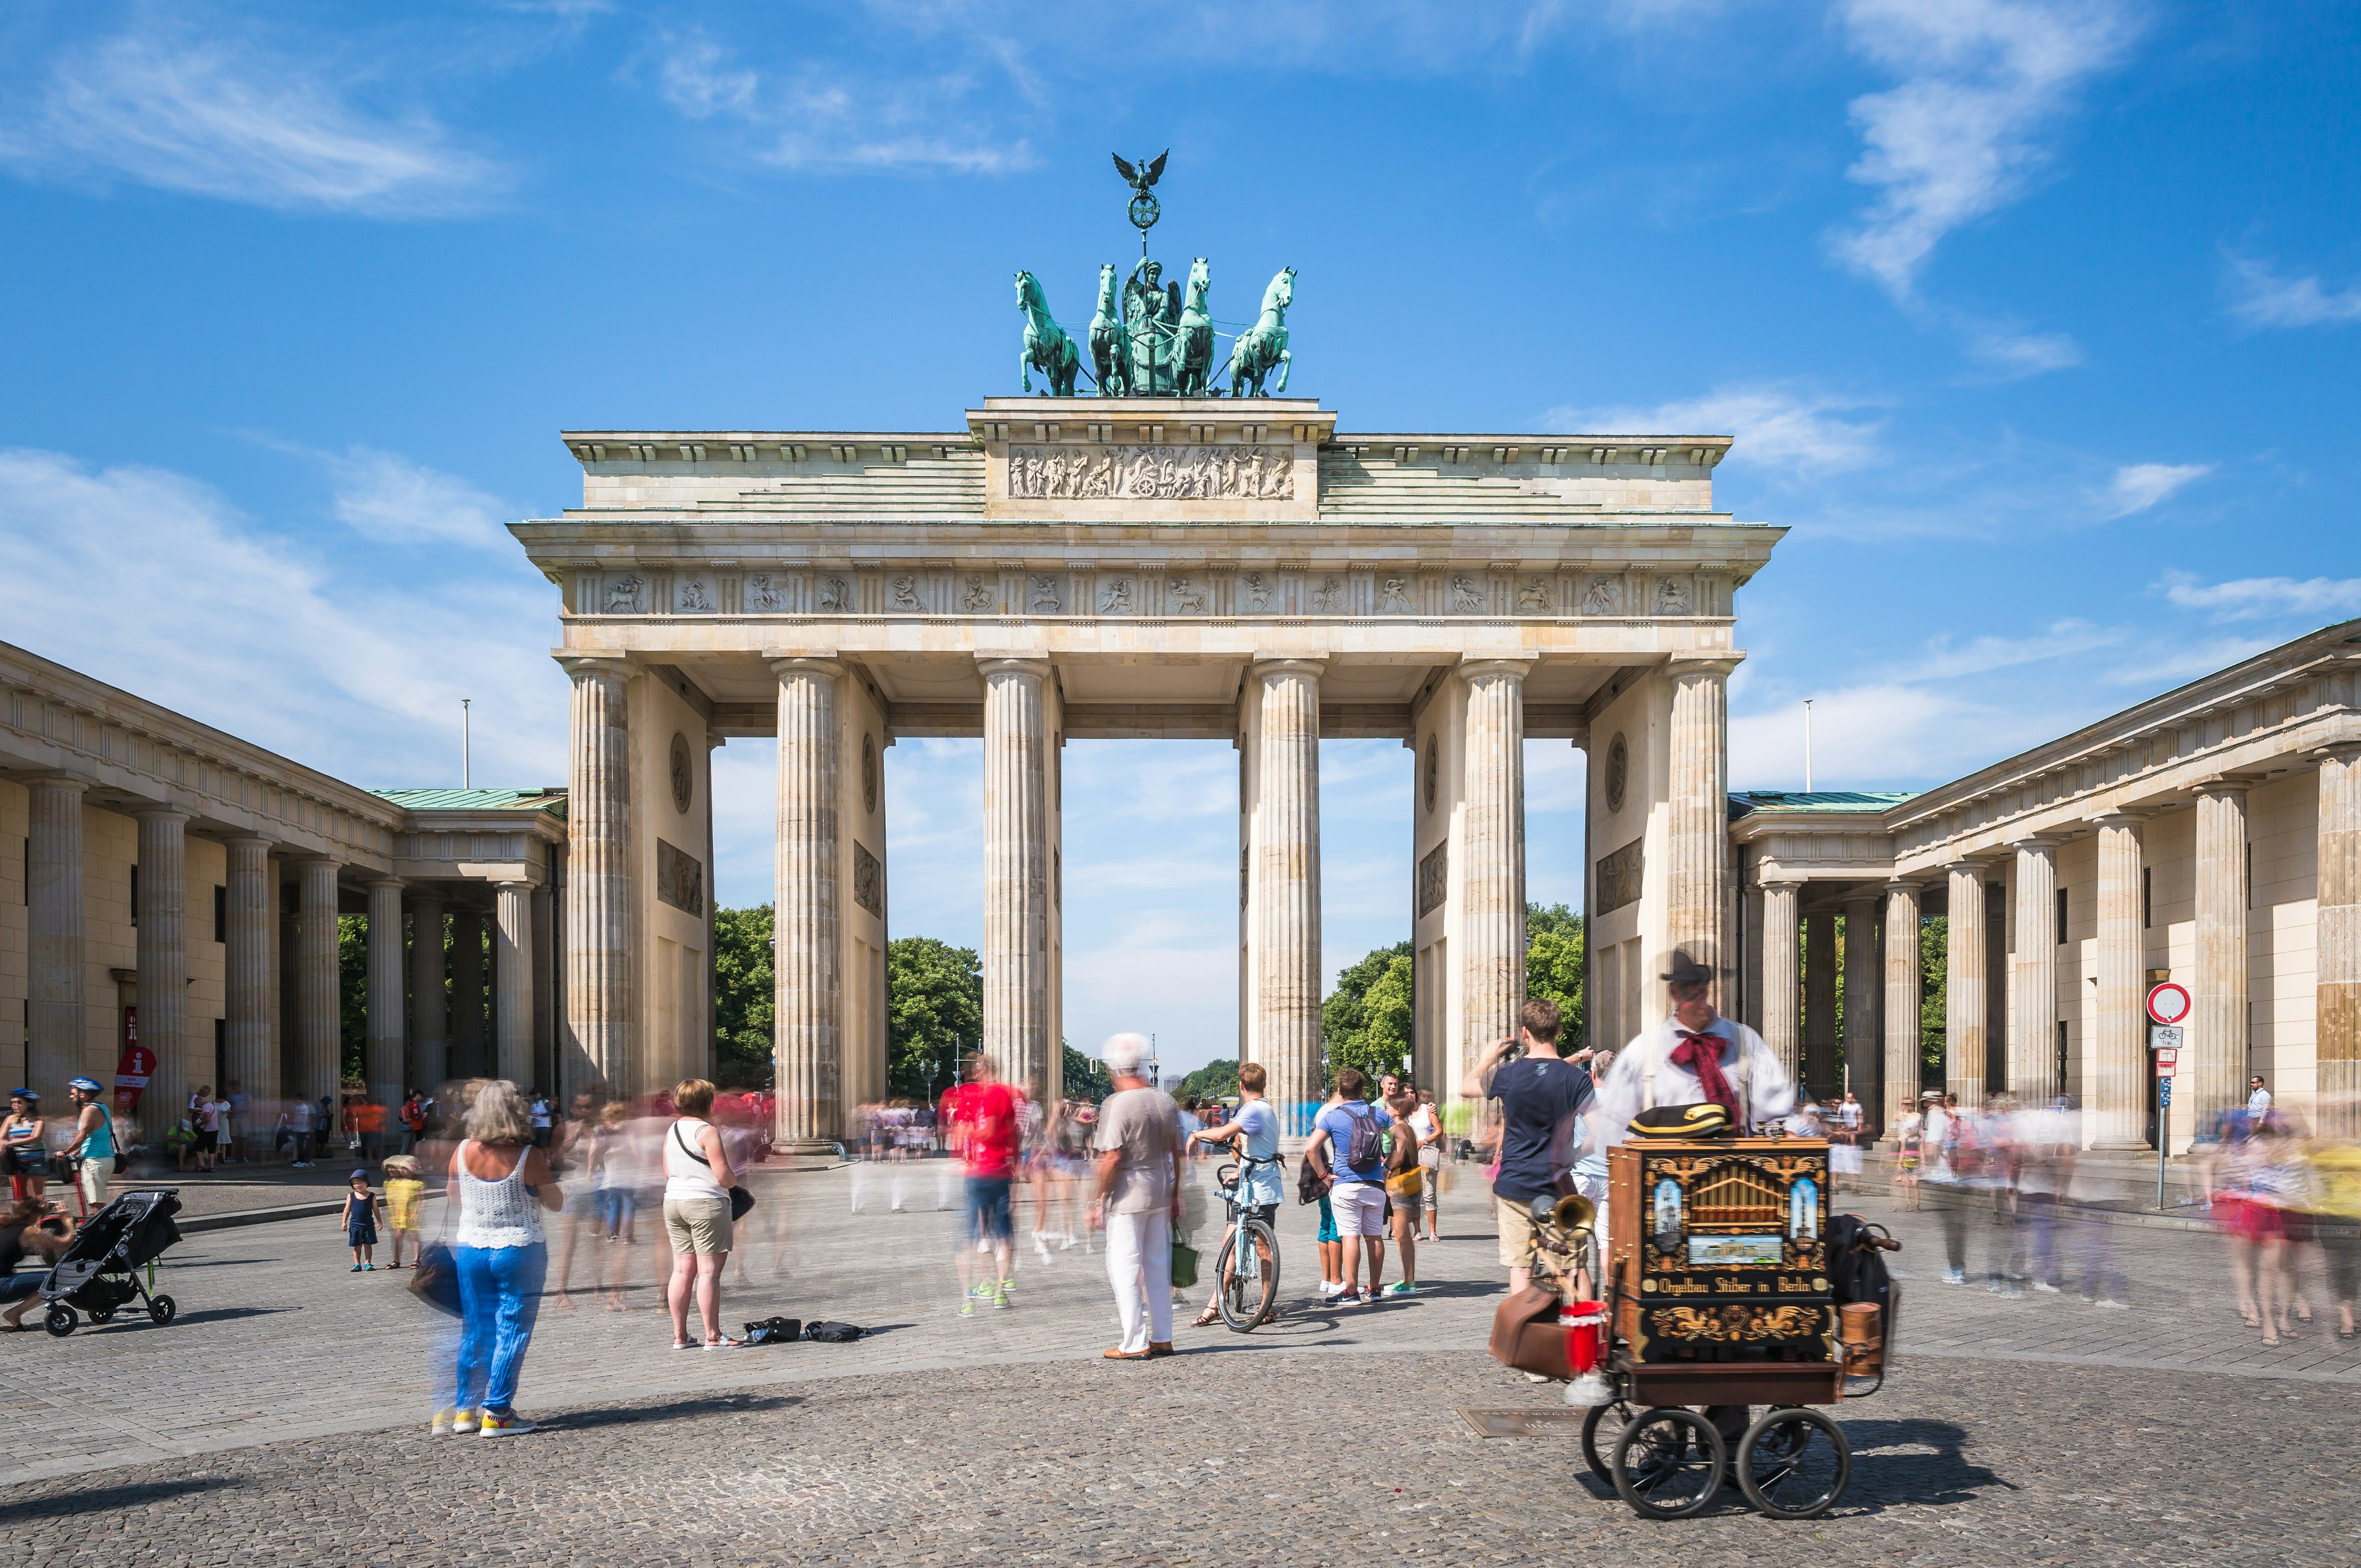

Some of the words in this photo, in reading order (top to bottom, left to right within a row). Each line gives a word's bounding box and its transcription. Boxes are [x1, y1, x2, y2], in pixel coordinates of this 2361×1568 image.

[132, 1052, 143, 1074] i
[1659, 1278, 1709, 1296] Orgelbau
[1757, 1282, 1770, 1292] in
[1778, 1277, 1811, 1292] Berlin
